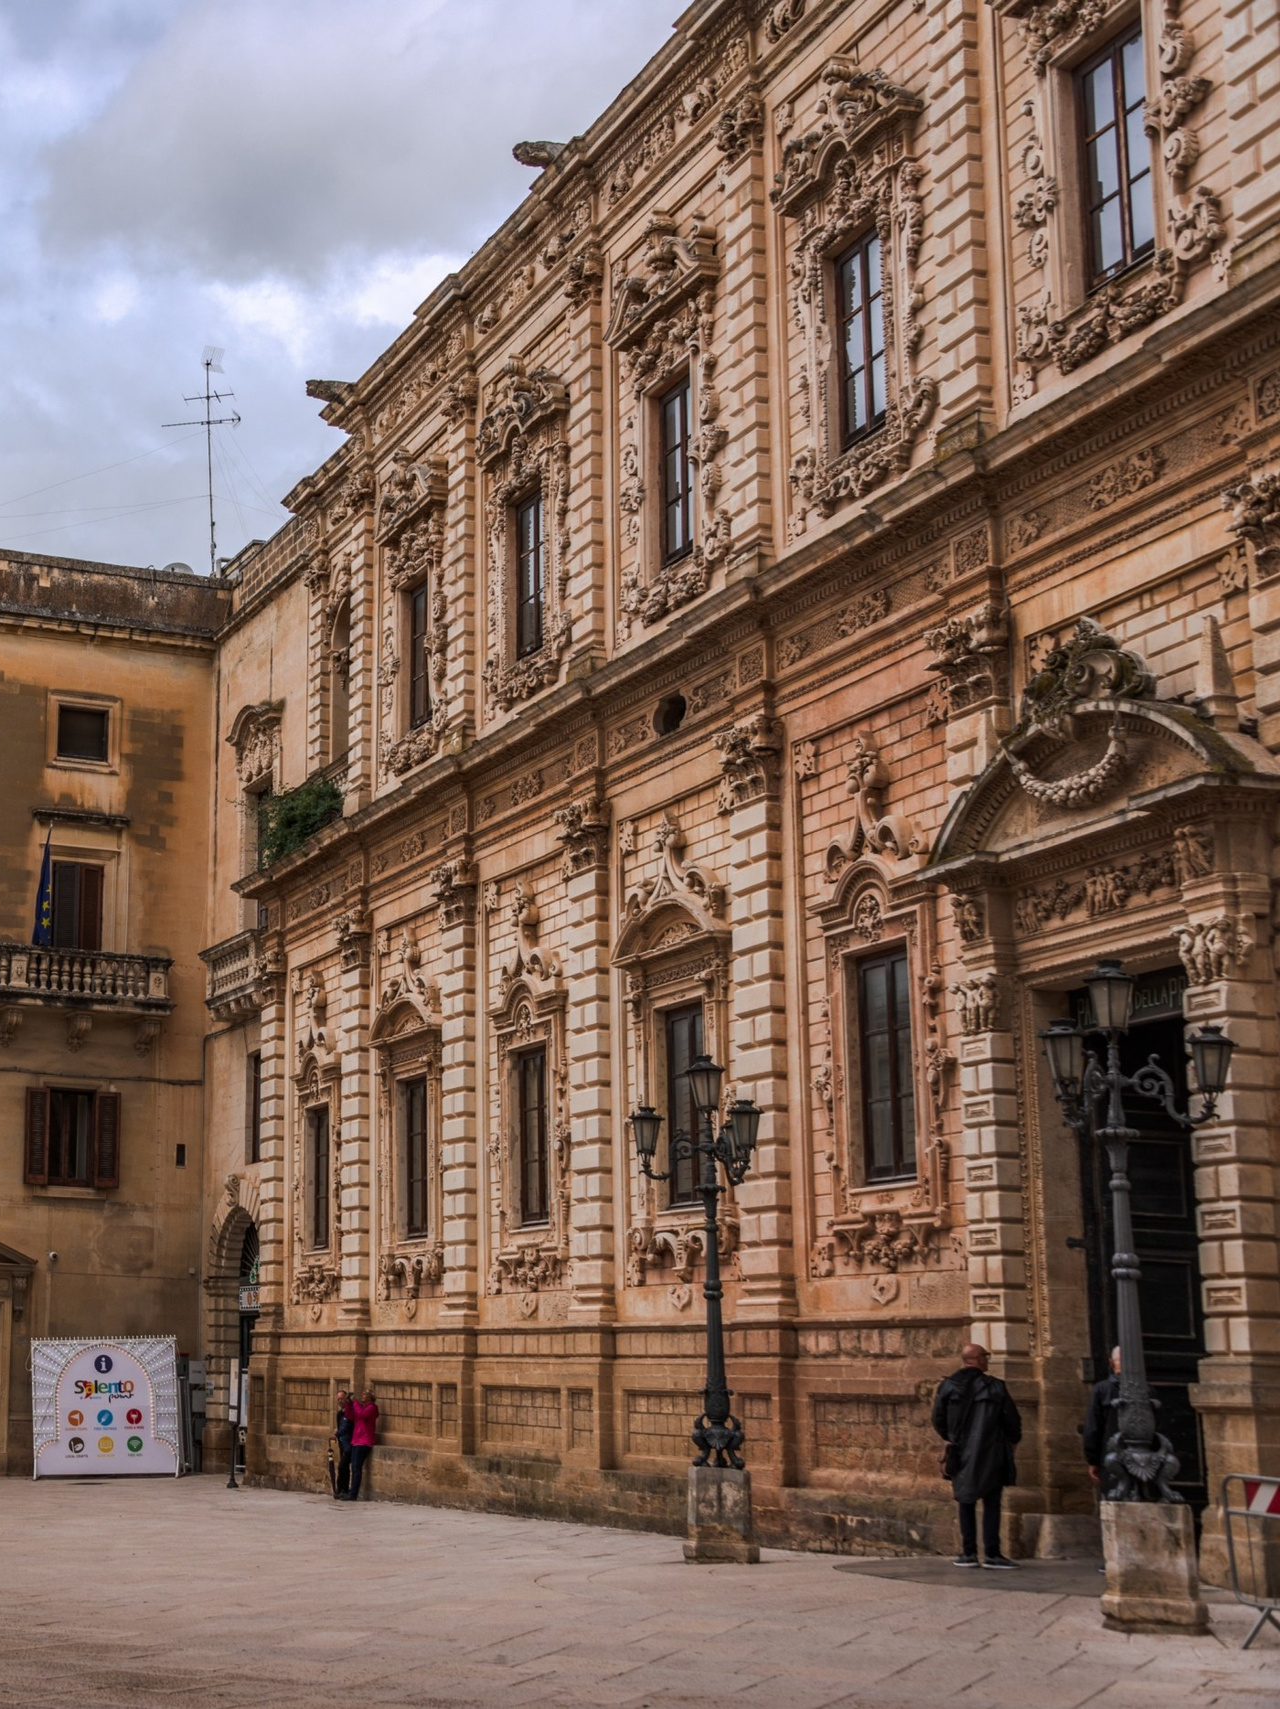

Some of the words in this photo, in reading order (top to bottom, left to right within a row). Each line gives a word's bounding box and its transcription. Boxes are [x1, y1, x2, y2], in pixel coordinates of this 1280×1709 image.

[1135, 985, 1168, 1010] DELLA
[74, 1379, 134, 1396] Salento
[108, 1392, 134, 1403] point
